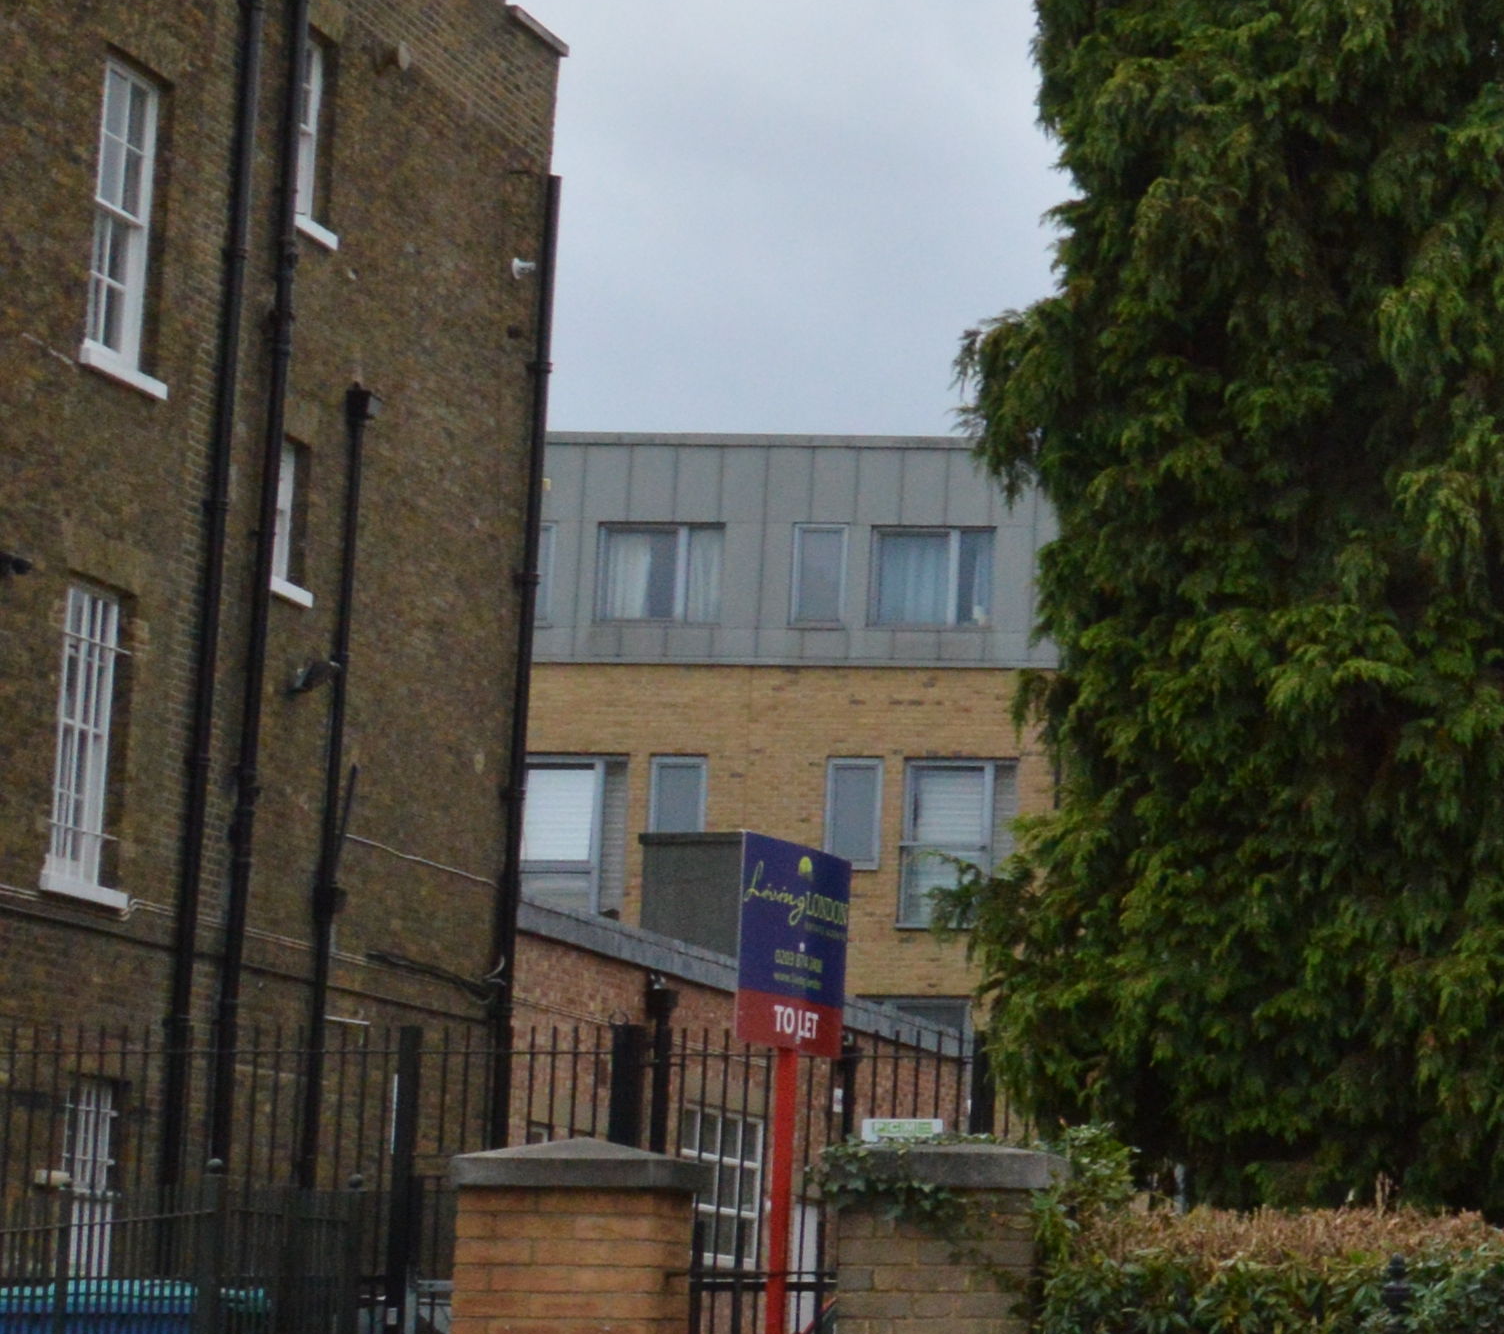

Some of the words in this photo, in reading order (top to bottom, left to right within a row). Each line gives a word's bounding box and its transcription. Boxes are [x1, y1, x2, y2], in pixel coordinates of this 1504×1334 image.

[743, 860, 805, 926] Living
[773, 1005, 795, 1034] TO
[797, 1009, 819, 1039] LET
